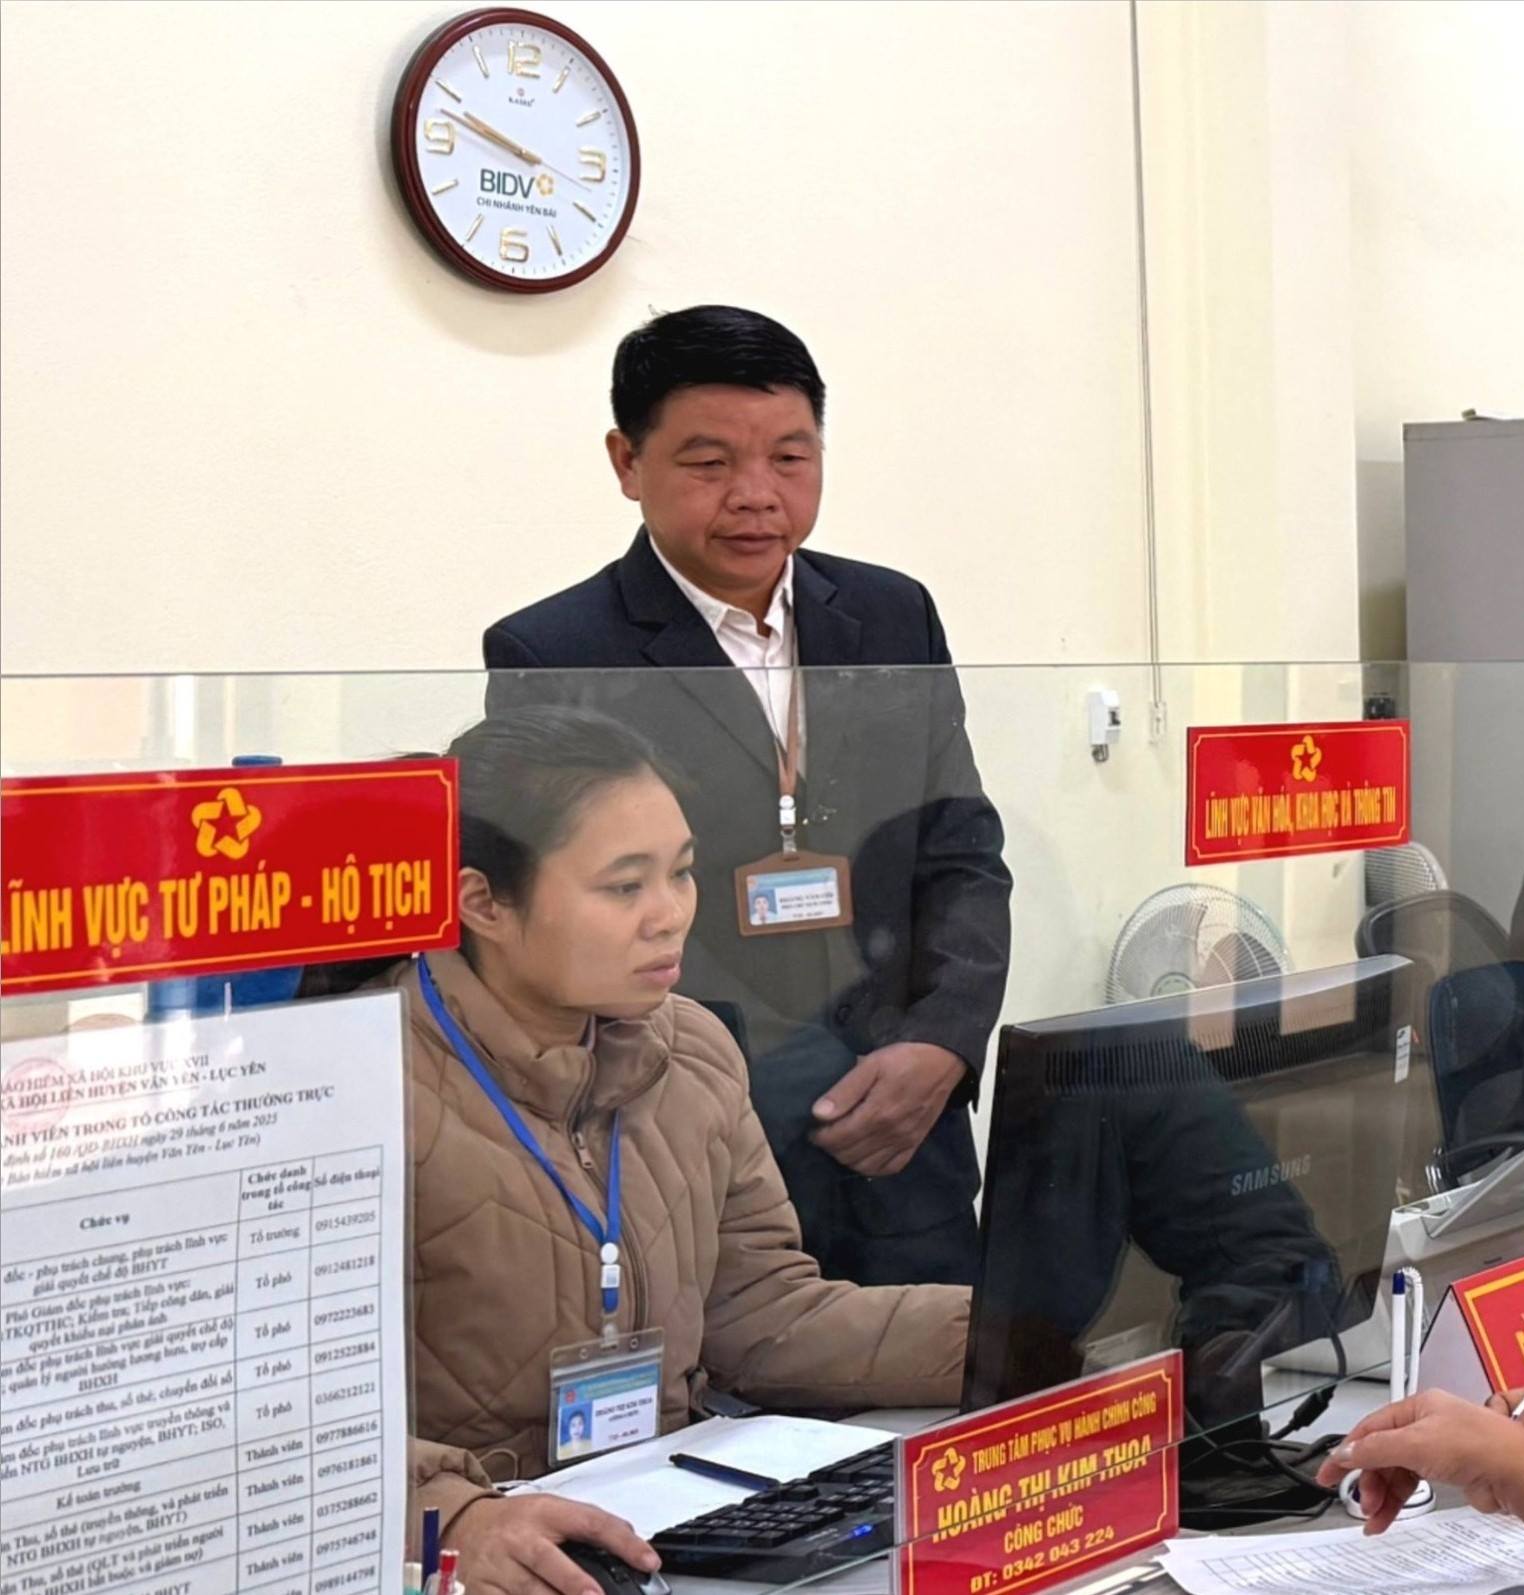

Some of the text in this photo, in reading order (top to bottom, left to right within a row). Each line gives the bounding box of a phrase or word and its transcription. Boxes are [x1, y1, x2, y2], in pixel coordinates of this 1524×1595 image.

[508, 40, 541, 79] 12
[424, 119, 455, 155] 9
[480, 168, 535, 198] BIDV
[578, 147, 606, 182] 3
[499, 227, 529, 262] 6
[0, 879, 72, 955] ĨNH
[83, 876, 149, 958] VỰC
[159, 871, 203, 940] TƯ
[209, 859, 291, 935] PHÁP
[322, 853, 360, 935] HỘ
[369, 859, 432, 930] TỊCH
[1231, 1154, 1311, 1196] SAMSUNG
[972, 1391, 1157, 1475] TRUNG TÂM PHỤC VỤ HÀNH CHÍNH CÔNG
[932, 1434, 1152, 1543] HOÀNG THỊ KIM THOA
[1004, 1502, 1084, 1554] CÔNG CHỨC
[1002, 1555, 1045, 1580] 0342
[1050, 1540, 1081, 1563] 043
[1085, 1525, 1115, 1550] 224
